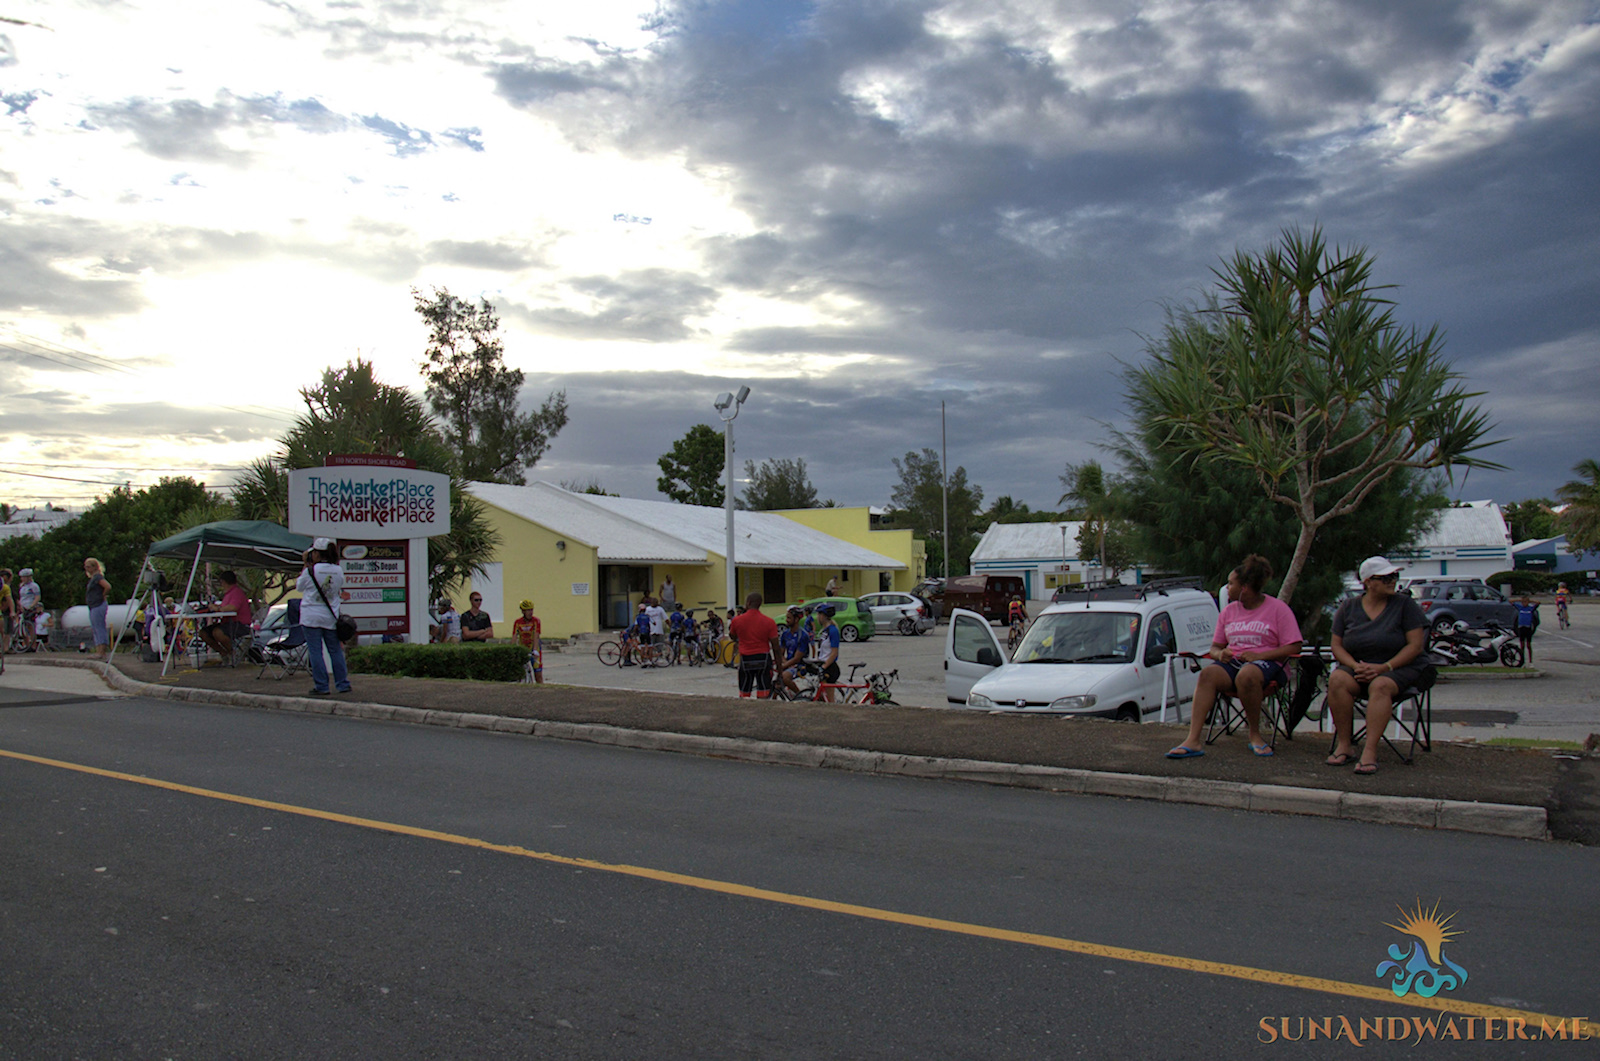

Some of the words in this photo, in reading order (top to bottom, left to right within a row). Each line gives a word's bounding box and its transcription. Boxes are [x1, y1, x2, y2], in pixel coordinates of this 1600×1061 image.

[345, 457, 367, 465] NORTH
[368, 458, 389, 466] SHORE
[389, 459, 407, 467] ROAD
[346, 562, 365, 571] Dollar
[380, 562, 398, 571] Depot
[345, 575, 370, 584] PIZZA
[372, 575, 399, 584] HOUSE
[351, 591, 382, 600] GARDINES
[1225, 621, 1270, 635] BERMUDA
